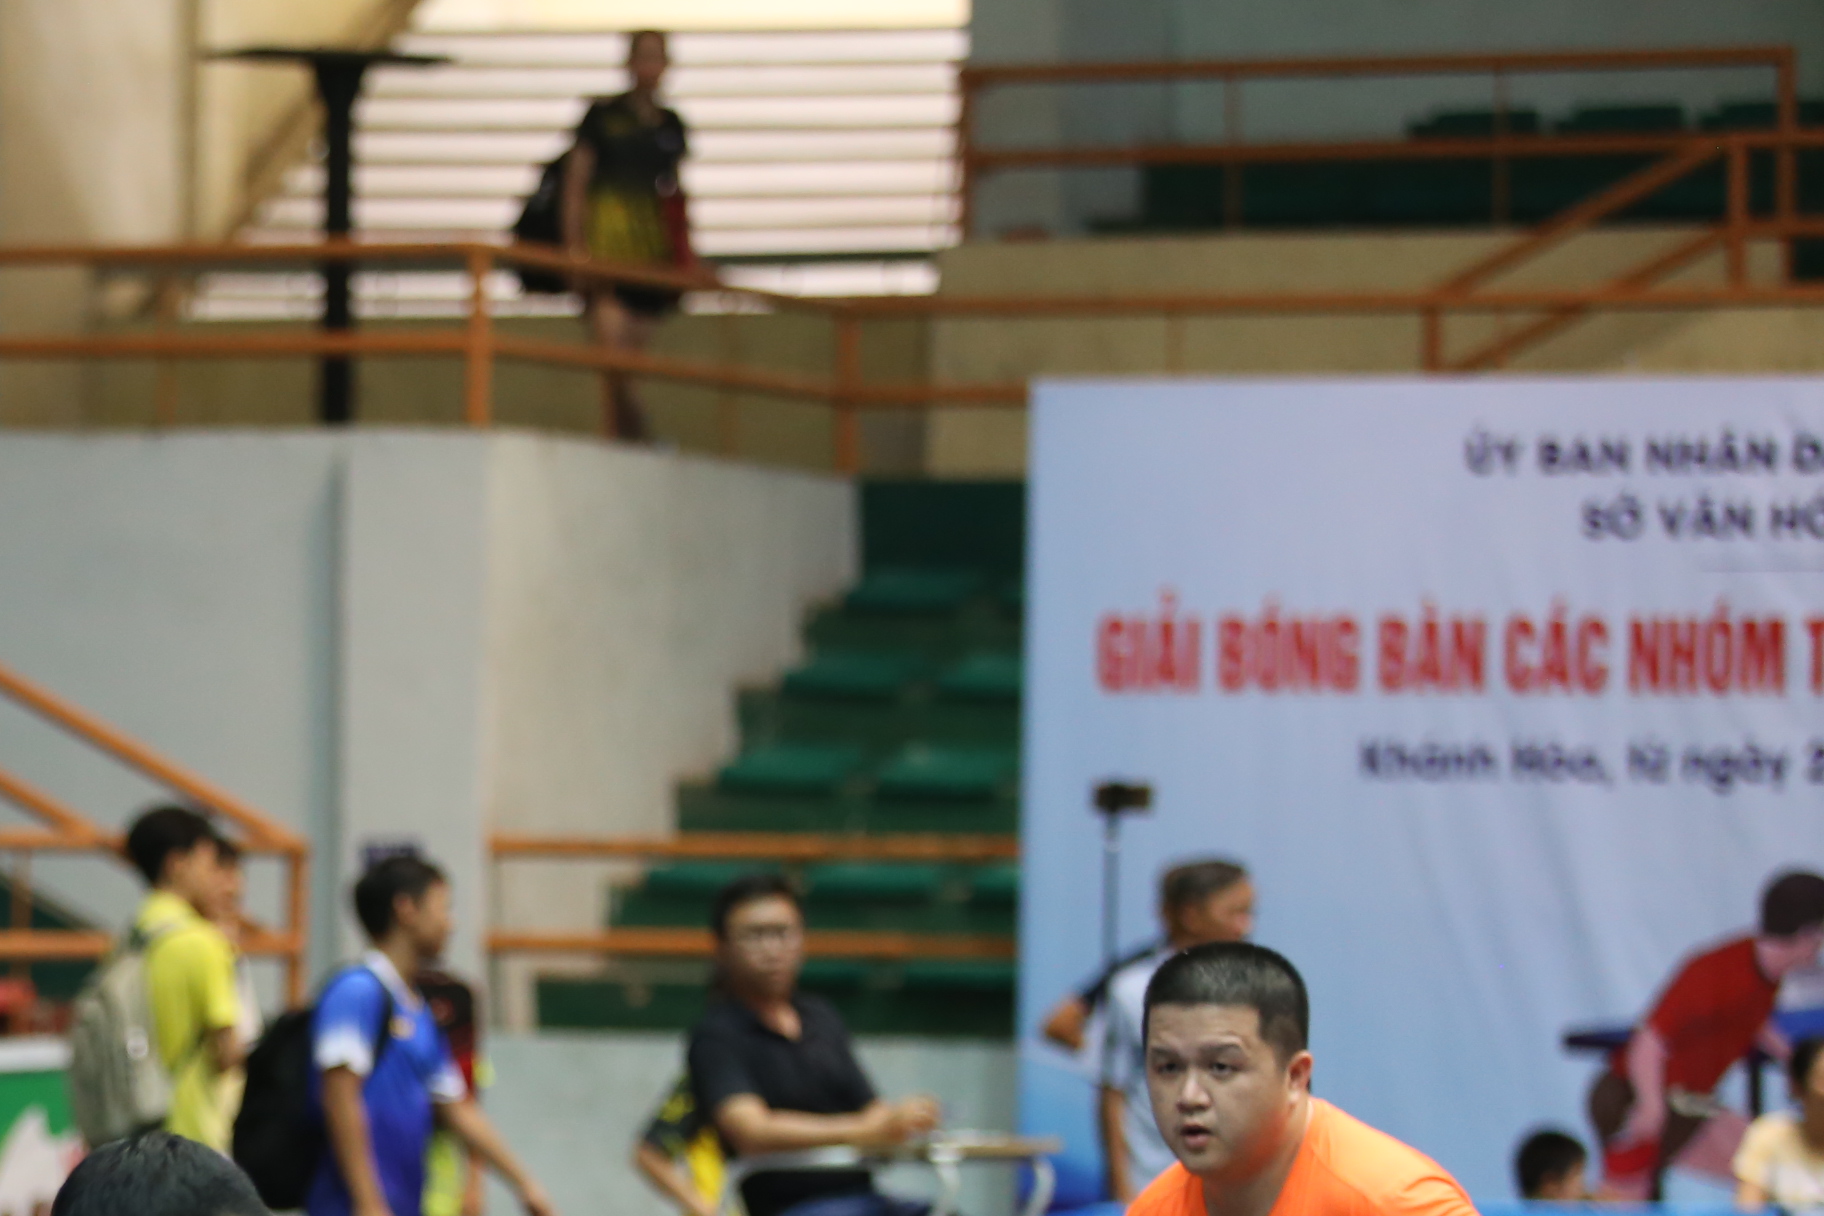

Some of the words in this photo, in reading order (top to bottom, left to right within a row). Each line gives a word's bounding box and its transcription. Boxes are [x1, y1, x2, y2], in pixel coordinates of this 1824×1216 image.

[1536, 434, 1631, 476] BAN
[1504, 596, 1610, 694] CÁC
[1628, 596, 1788, 694] NHÓM
